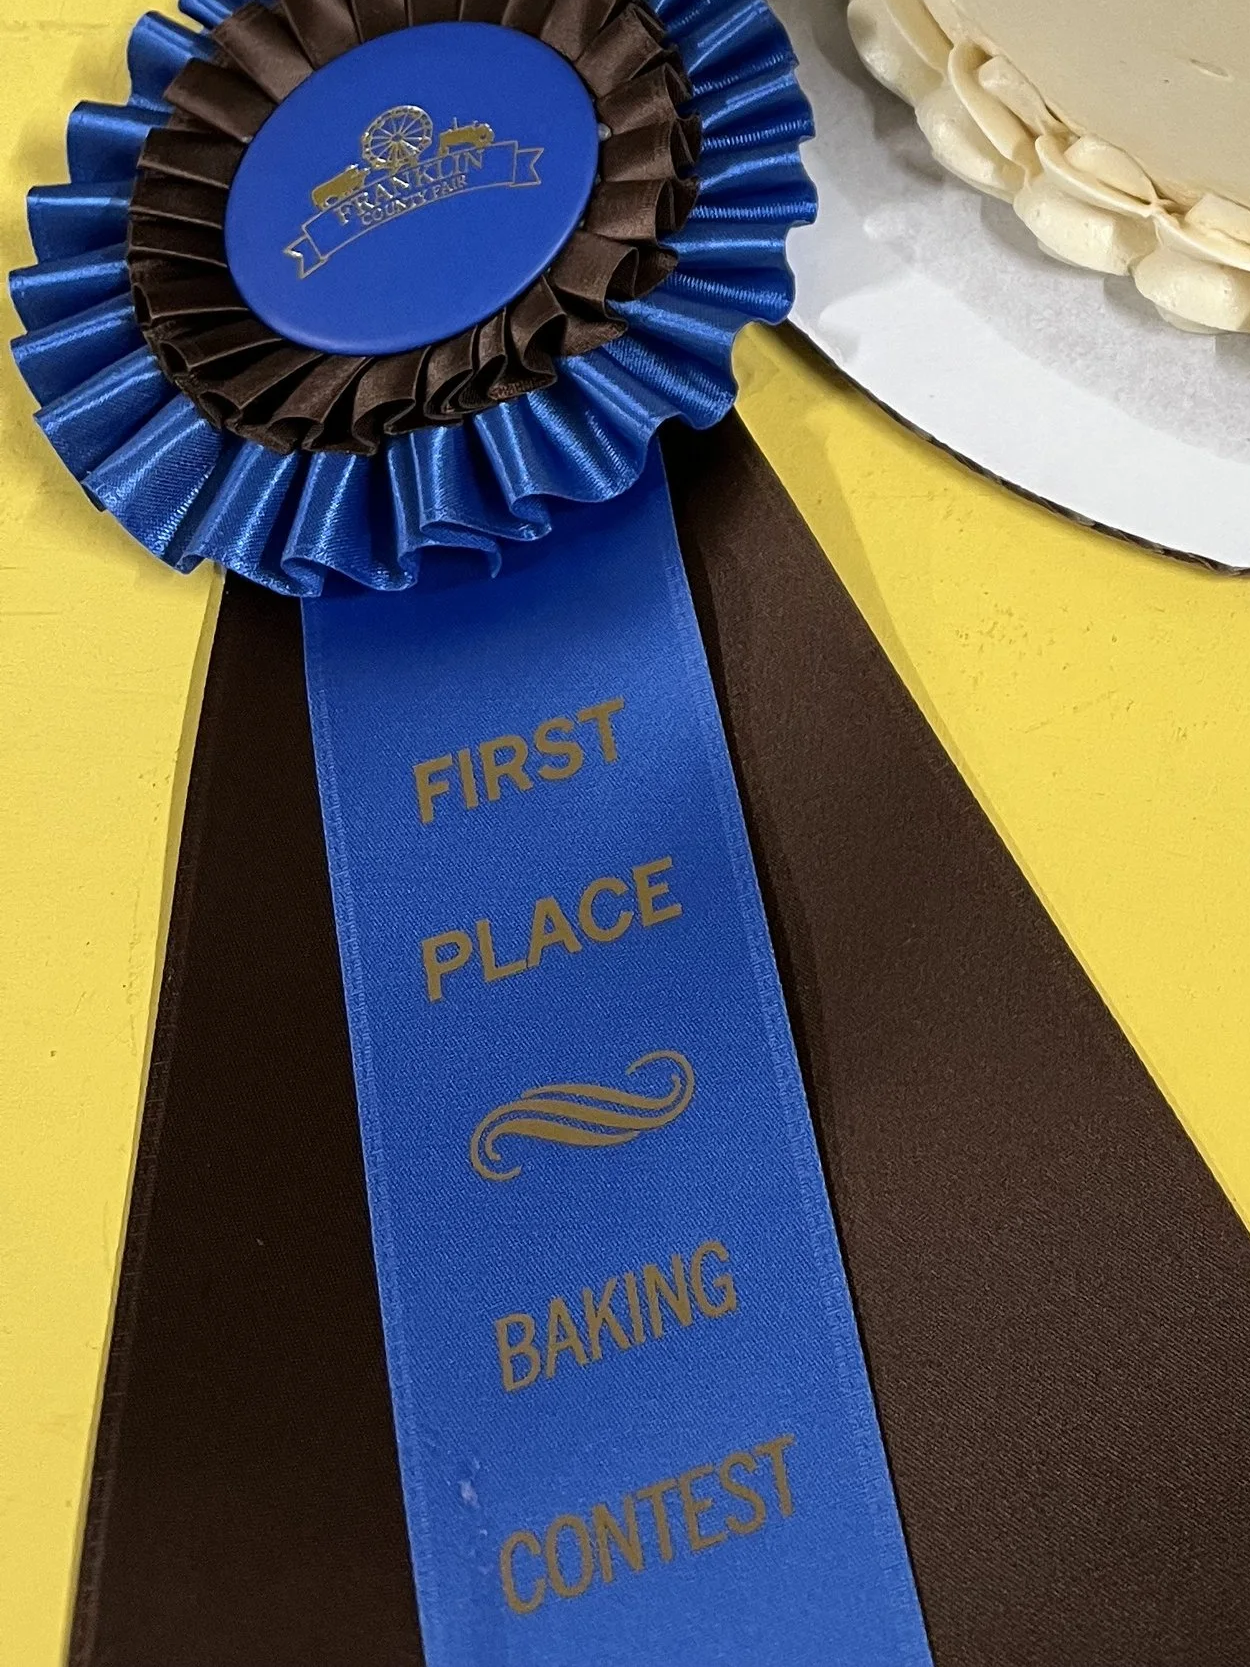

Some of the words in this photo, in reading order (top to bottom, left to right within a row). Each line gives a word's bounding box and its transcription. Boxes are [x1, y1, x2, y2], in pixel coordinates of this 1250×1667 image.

[333, 149, 484, 225] FRANKLIN
[360, 190, 425, 226] COUNTY
[431, 174, 469, 200] FAIR
[412, 696, 625, 824] FIRST
[420, 855, 682, 1003] PLACE
[495, 1240, 738, 1393] BAKING
[501, 1432, 796, 1615] CONTEST
